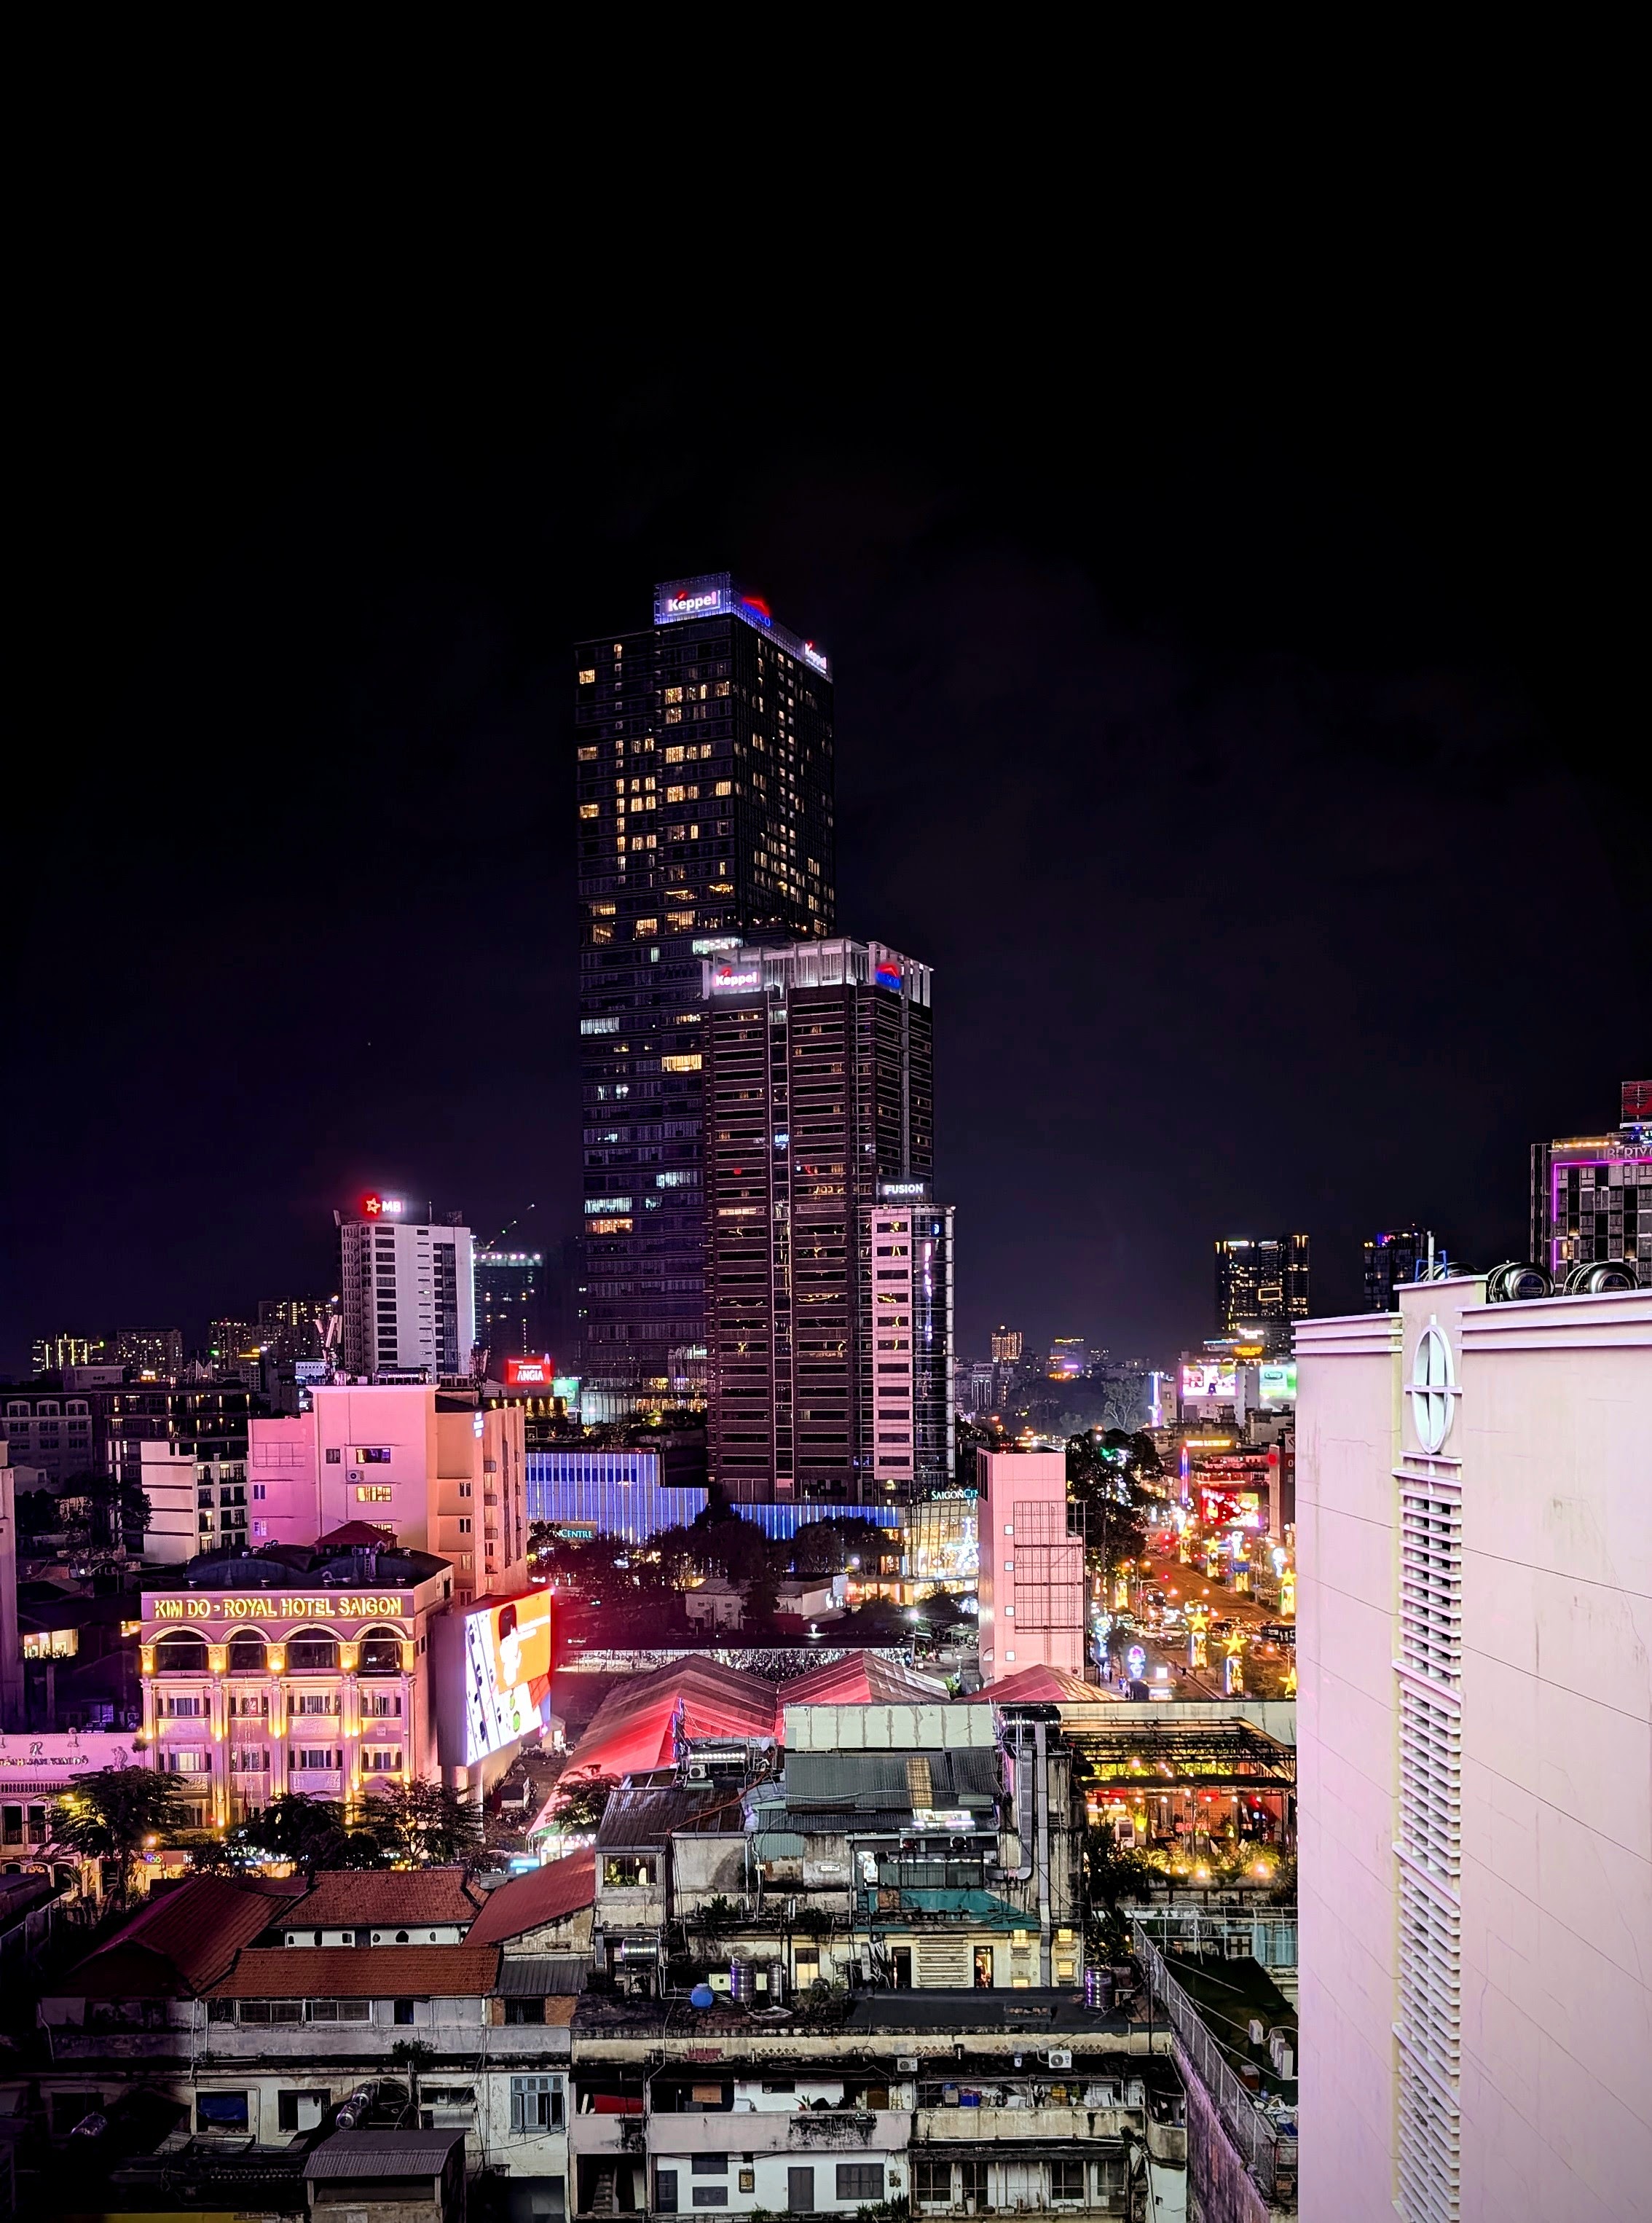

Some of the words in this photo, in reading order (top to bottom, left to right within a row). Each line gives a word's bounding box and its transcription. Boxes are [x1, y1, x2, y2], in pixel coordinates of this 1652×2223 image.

[668, 591, 717, 612] Keppel
[715, 971, 758, 987] Keppel
[1596, 1146, 1648, 1161] LIBERTY
[884, 1183, 924, 1195] FUSION
[382, 1200, 401, 1212] MB
[154, 1600, 183, 1619] KIM
[186, 1599, 211, 1619] DO
[223, 1599, 278, 1618] ROYAL
[280, 1598, 335, 1617] HOTEL
[339, 1596, 402, 1616] SAIGON
